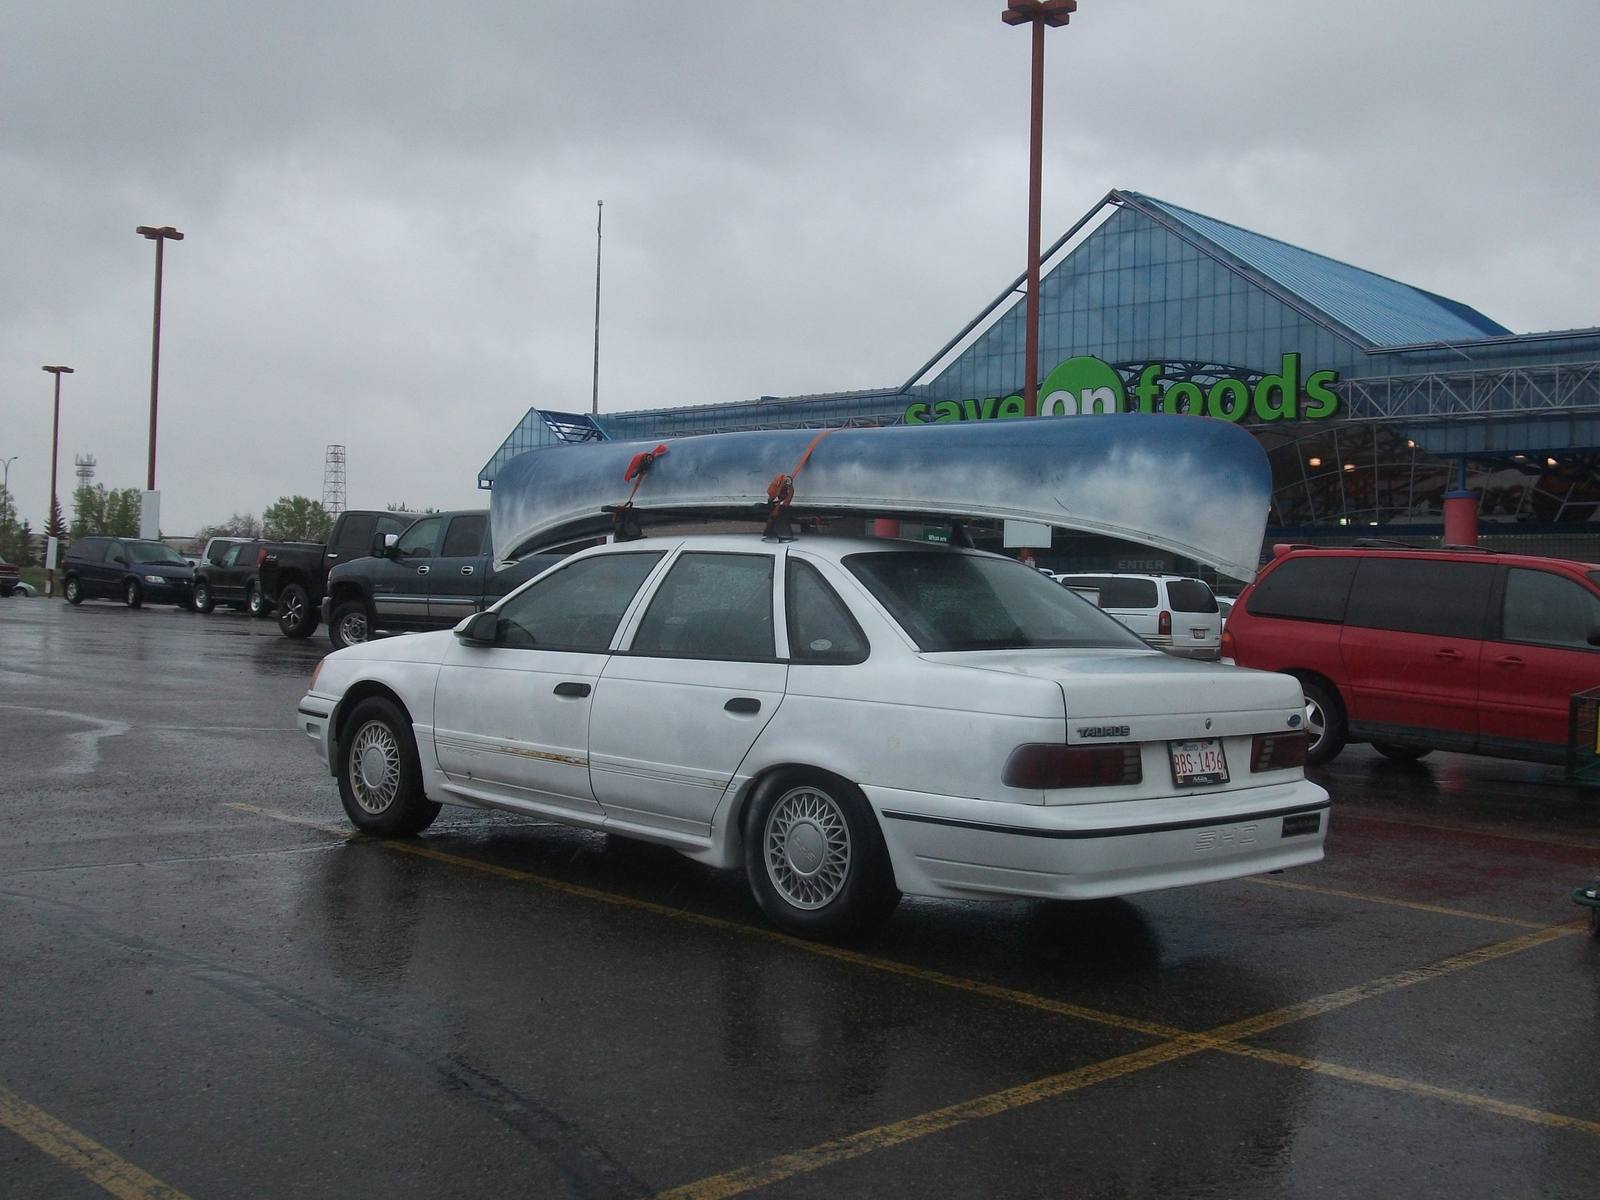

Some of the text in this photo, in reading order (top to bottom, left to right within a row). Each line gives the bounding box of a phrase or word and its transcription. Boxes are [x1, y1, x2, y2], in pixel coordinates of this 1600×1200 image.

[1041, 386, 1116, 416] on
[1135, 353, 1340, 423] foods
[1118, 559, 1165, 570] ENTER
[1078, 726, 1131, 738] TAURUS
